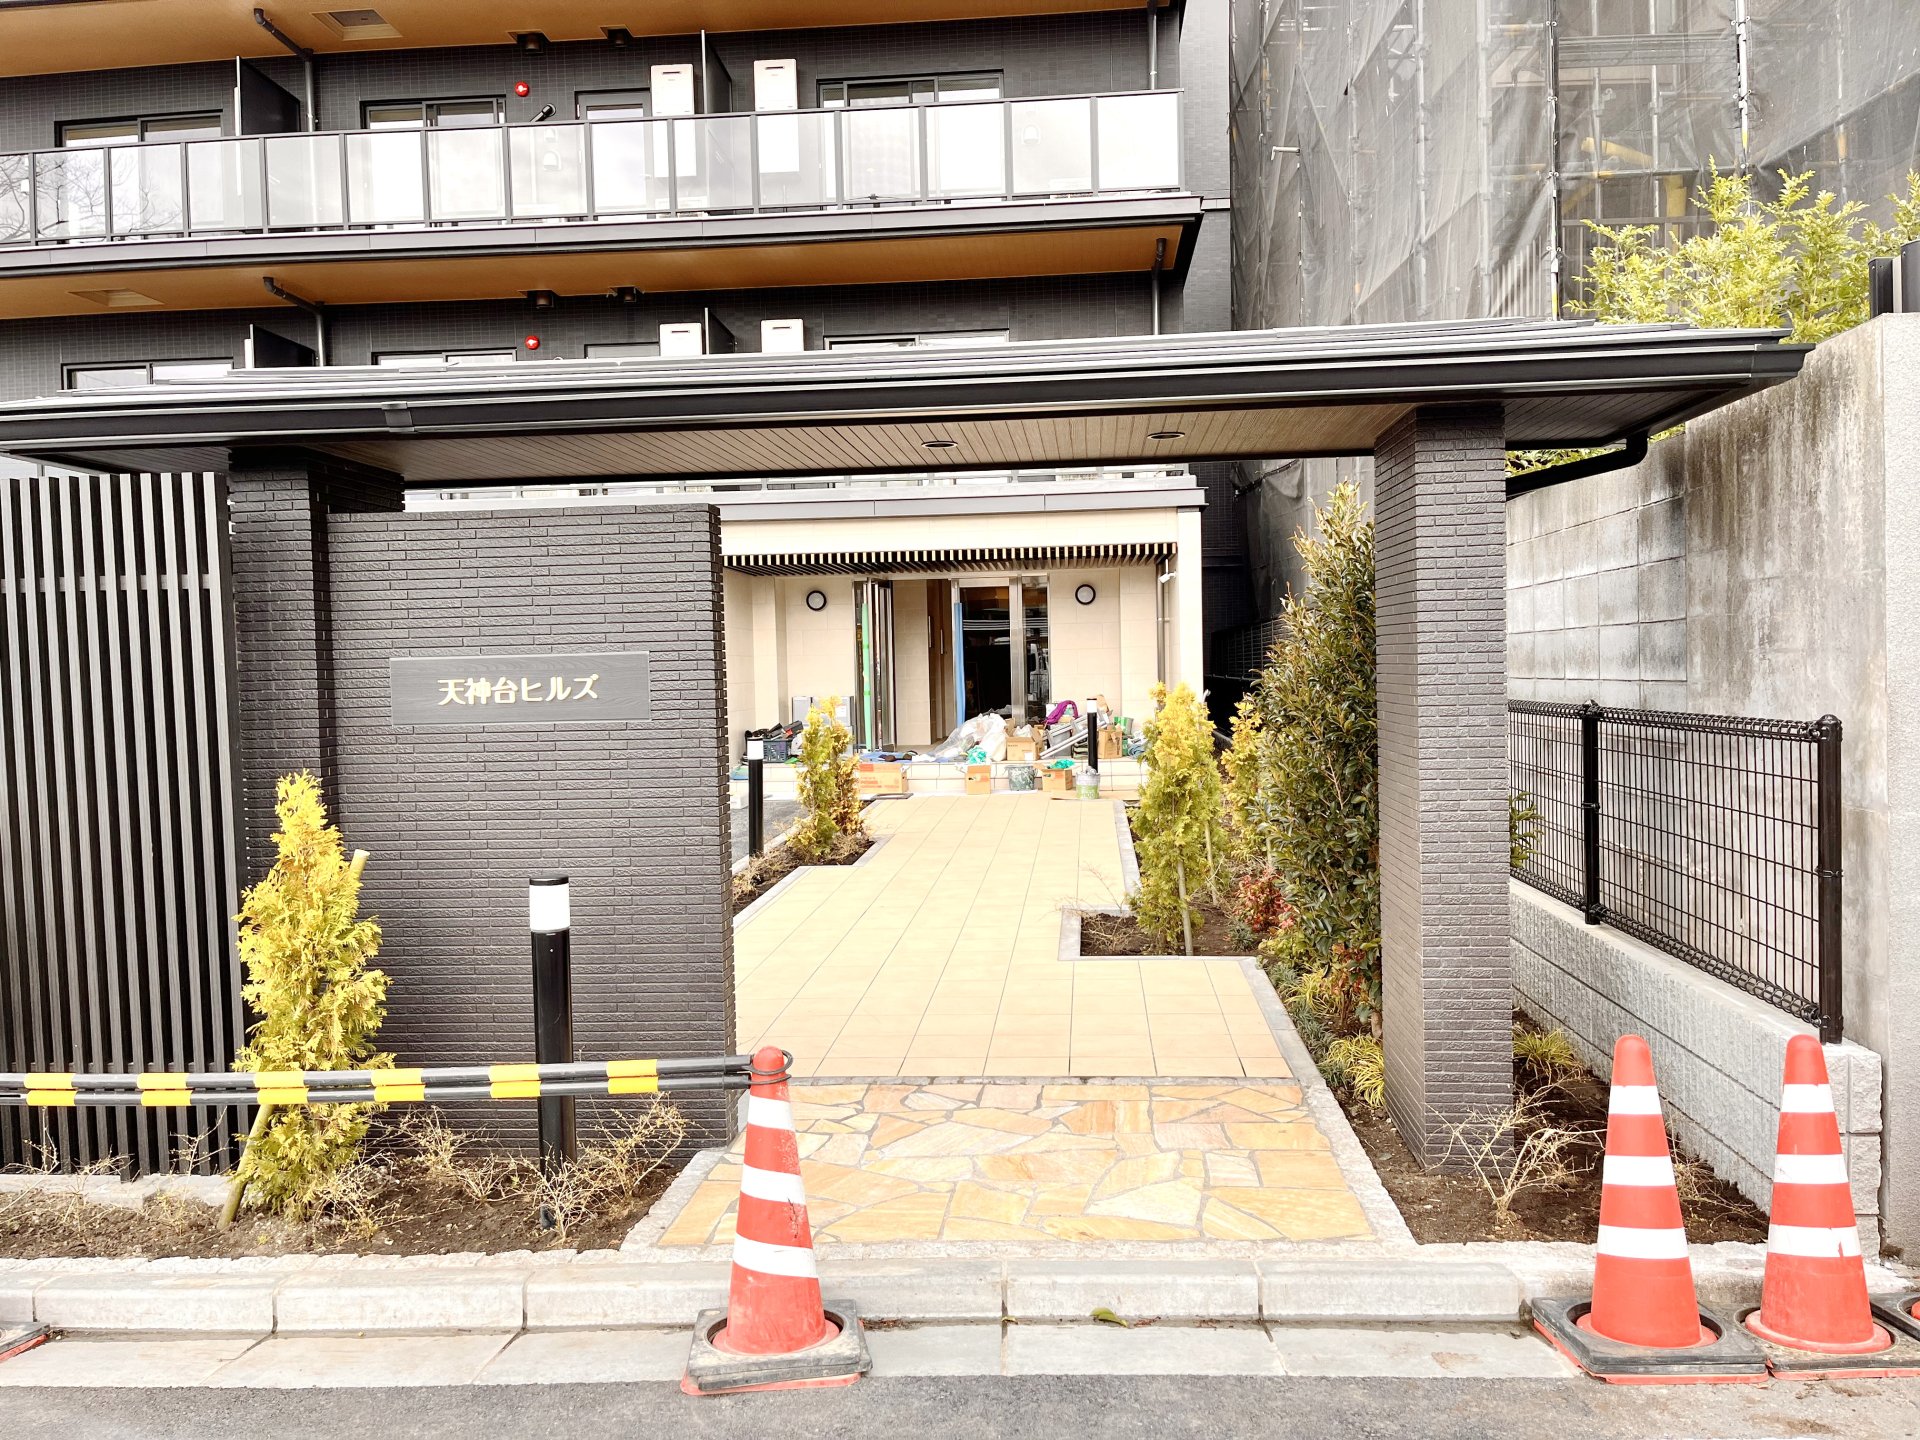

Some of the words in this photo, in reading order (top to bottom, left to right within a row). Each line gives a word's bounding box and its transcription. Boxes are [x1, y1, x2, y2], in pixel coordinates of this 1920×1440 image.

[437, 673, 599, 705] 天神台ヒルズ
